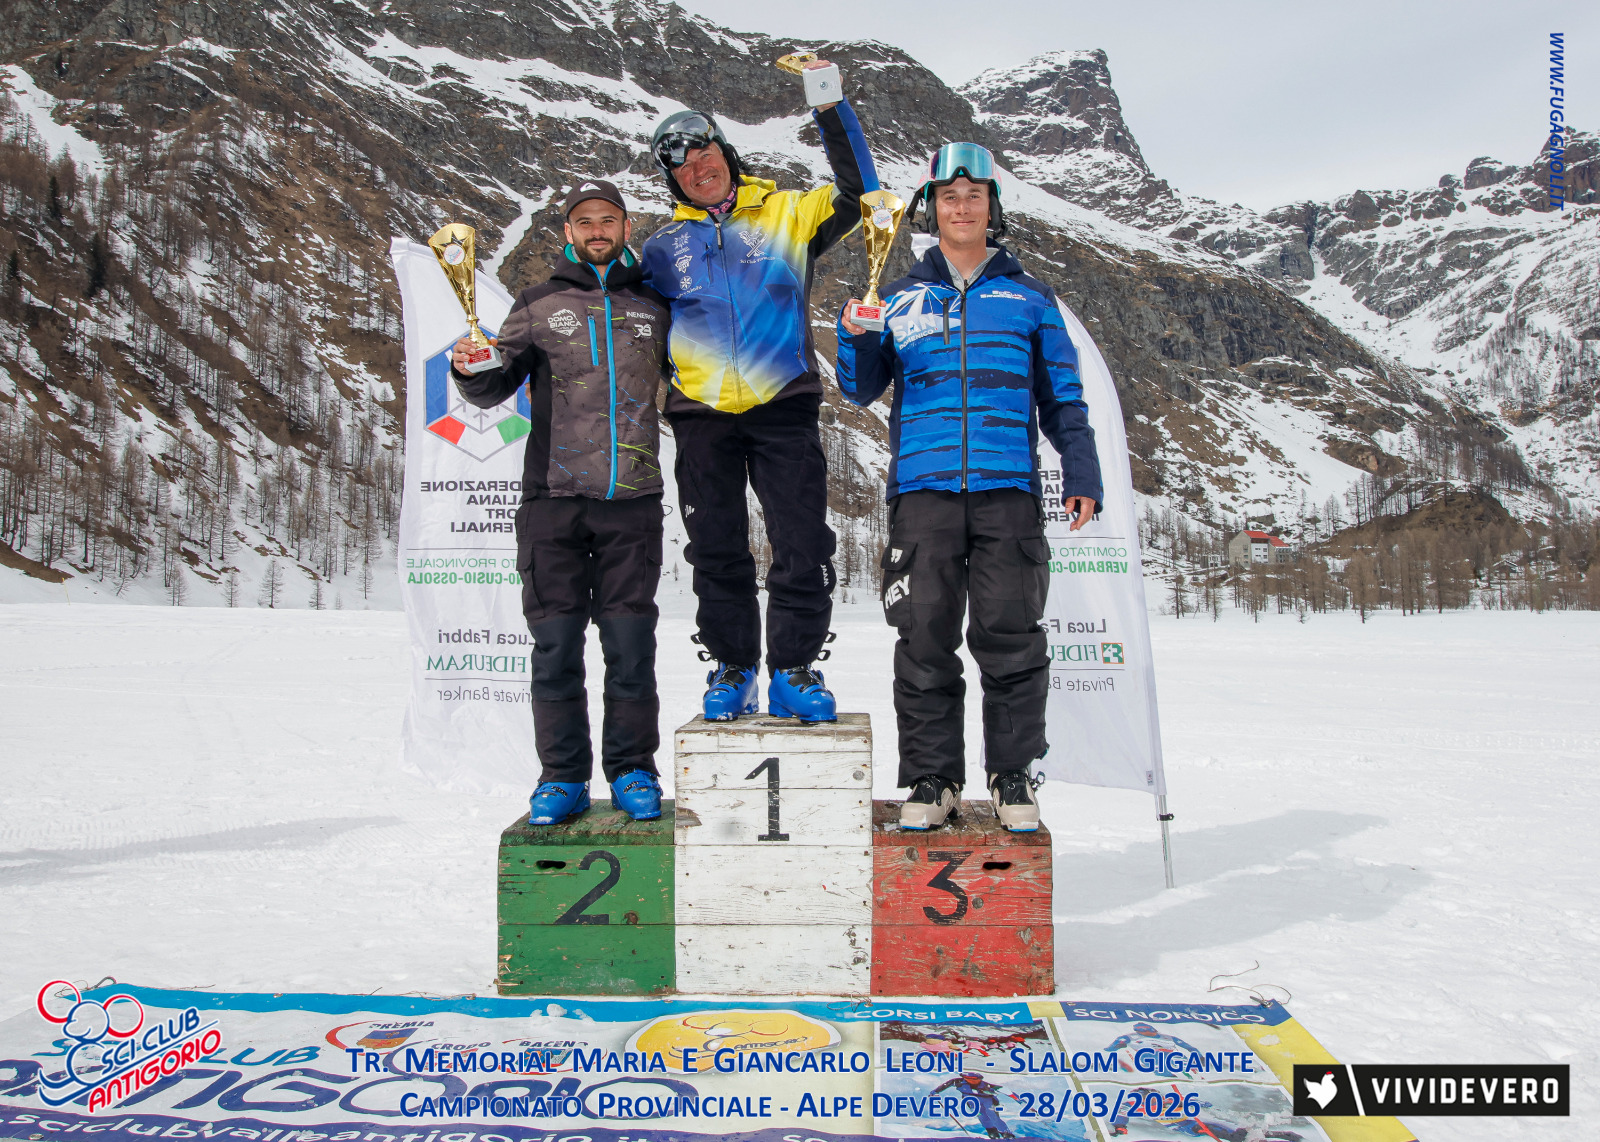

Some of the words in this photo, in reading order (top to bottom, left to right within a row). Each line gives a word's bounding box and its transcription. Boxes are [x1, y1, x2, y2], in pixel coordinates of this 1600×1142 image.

[547, 315, 574, 324] DOMO
[549, 320, 582, 329] BIANCA
[892, 312, 937, 343] SAN
[884, 574, 910, 610] HEY
[743, 756, 790, 842] 1
[555, 849, 622, 926] 2
[922, 850, 974, 925] 3
[853, 1009, 936, 1020] CORSI
[946, 1010, 1020, 1022] BABY
[1073, 1008, 1117, 1020] SCI
[1123, 1009, 1265, 1023] NORDICO
